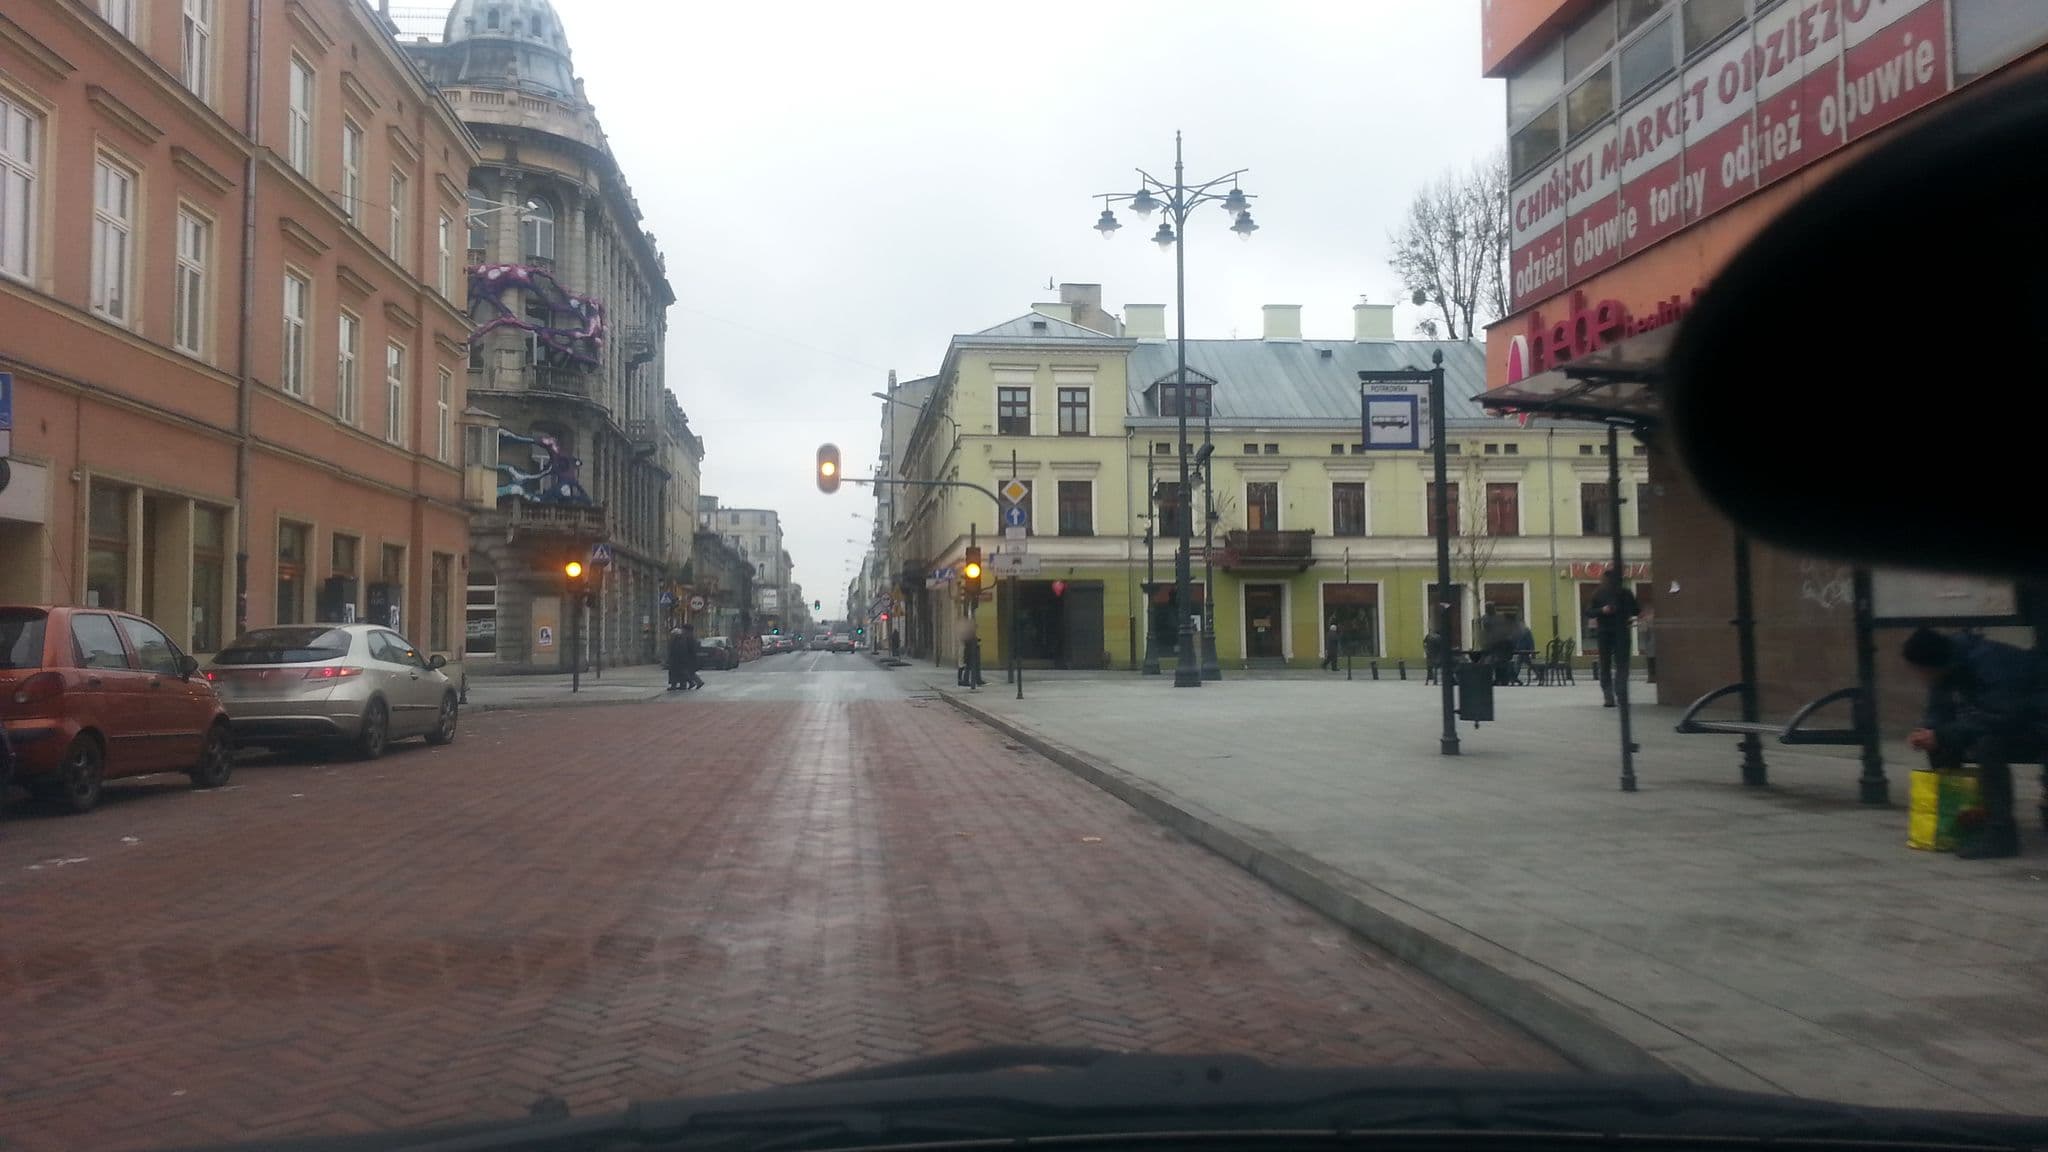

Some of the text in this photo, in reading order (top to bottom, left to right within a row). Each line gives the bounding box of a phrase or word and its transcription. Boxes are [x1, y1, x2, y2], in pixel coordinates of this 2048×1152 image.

[1515, 152, 1593, 233] CHIŃSKI
[1601, 76, 1709, 181] MARKET
[1516, 237, 1565, 298] odzież
[1573, 201, 1638, 267] obuwie
[1649, 167, 1706, 226] torby
[1819, 31, 1936, 136] obuwie
[1528, 290, 1627, 373] hebe
